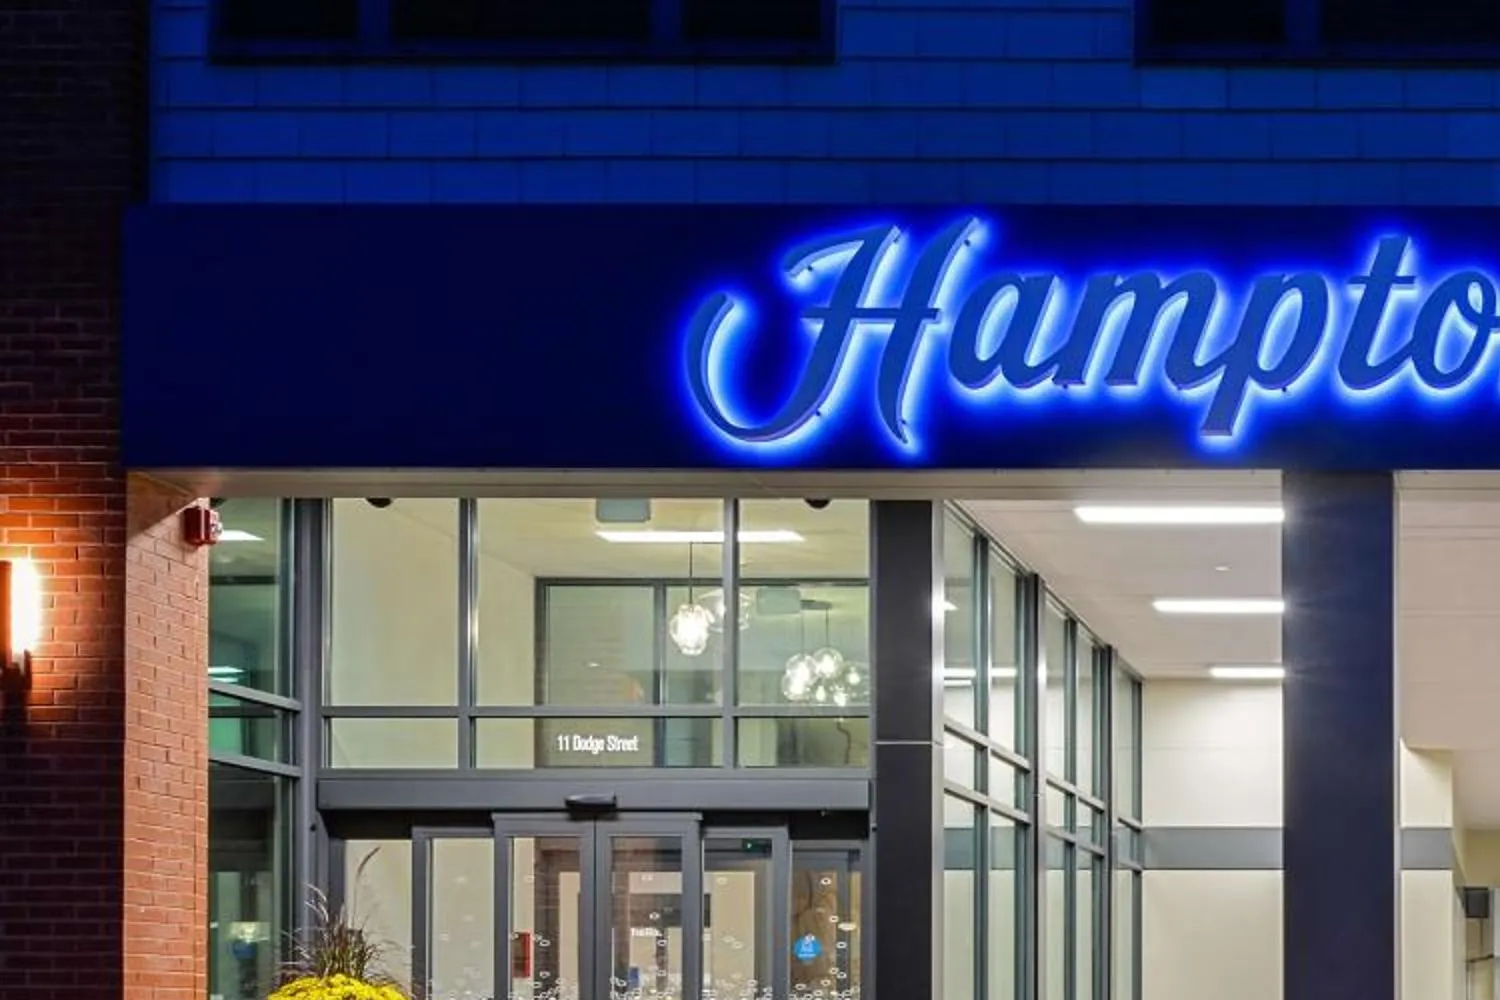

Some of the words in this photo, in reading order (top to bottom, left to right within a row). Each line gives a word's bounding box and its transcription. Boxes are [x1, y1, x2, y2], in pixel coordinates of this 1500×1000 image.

[557, 734, 570, 751] 11
[572, 734, 605, 754] Dodge
[606, 734, 640, 751] Street
